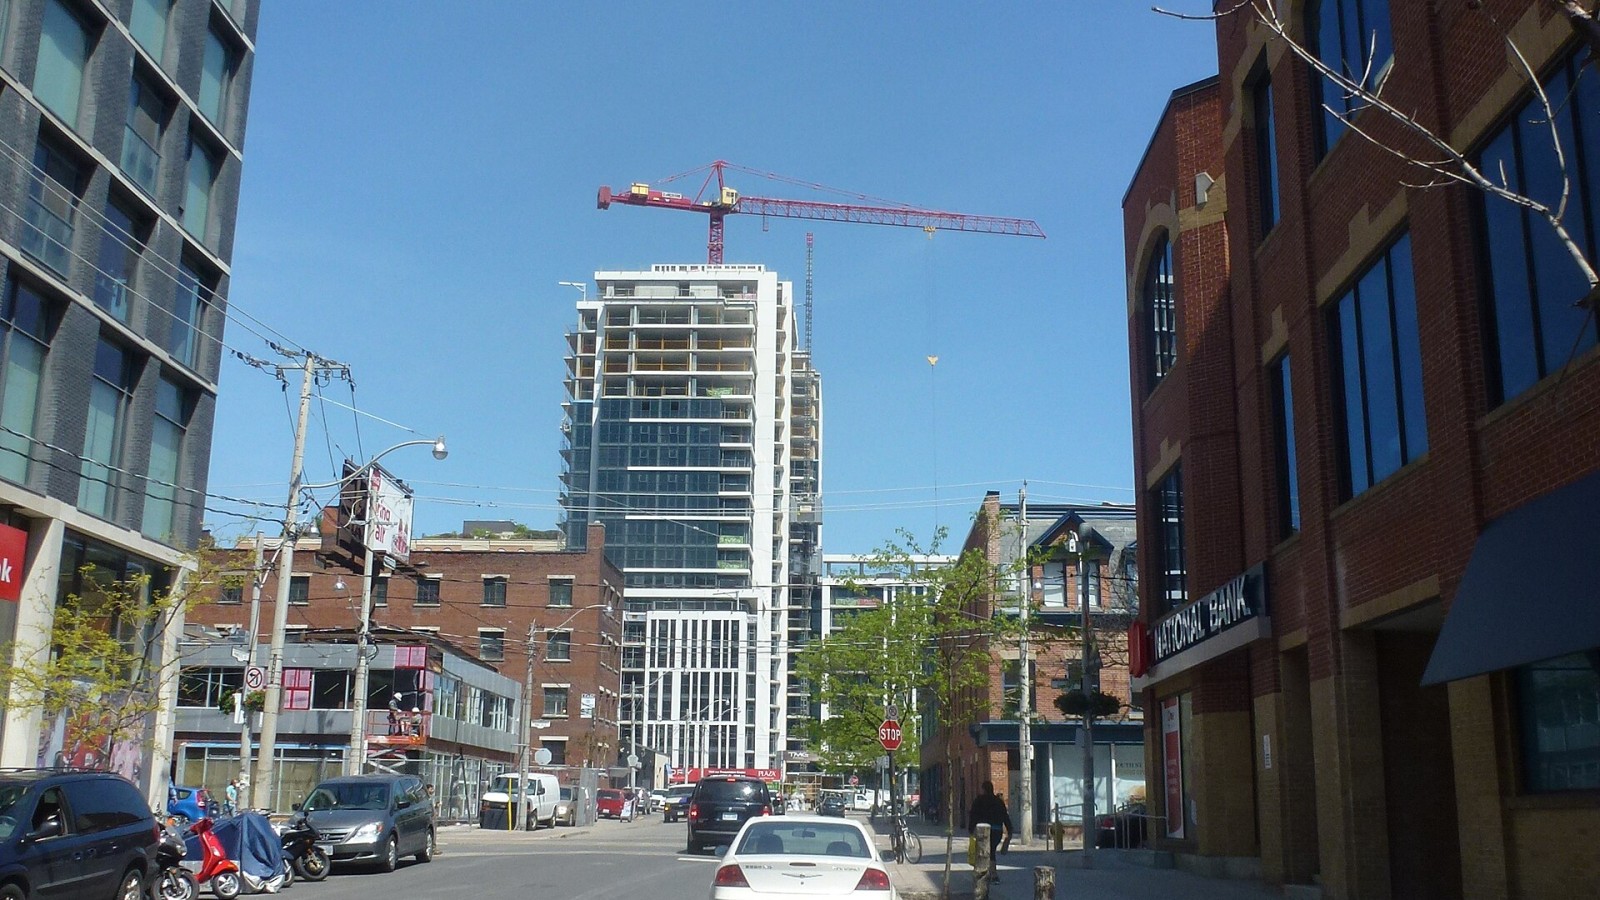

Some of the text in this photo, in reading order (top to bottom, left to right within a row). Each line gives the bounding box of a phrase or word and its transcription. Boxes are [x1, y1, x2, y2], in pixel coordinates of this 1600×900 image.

[1154, 574, 1251, 661] NATIONAL BANK
[880, 728, 901, 741] STOP
